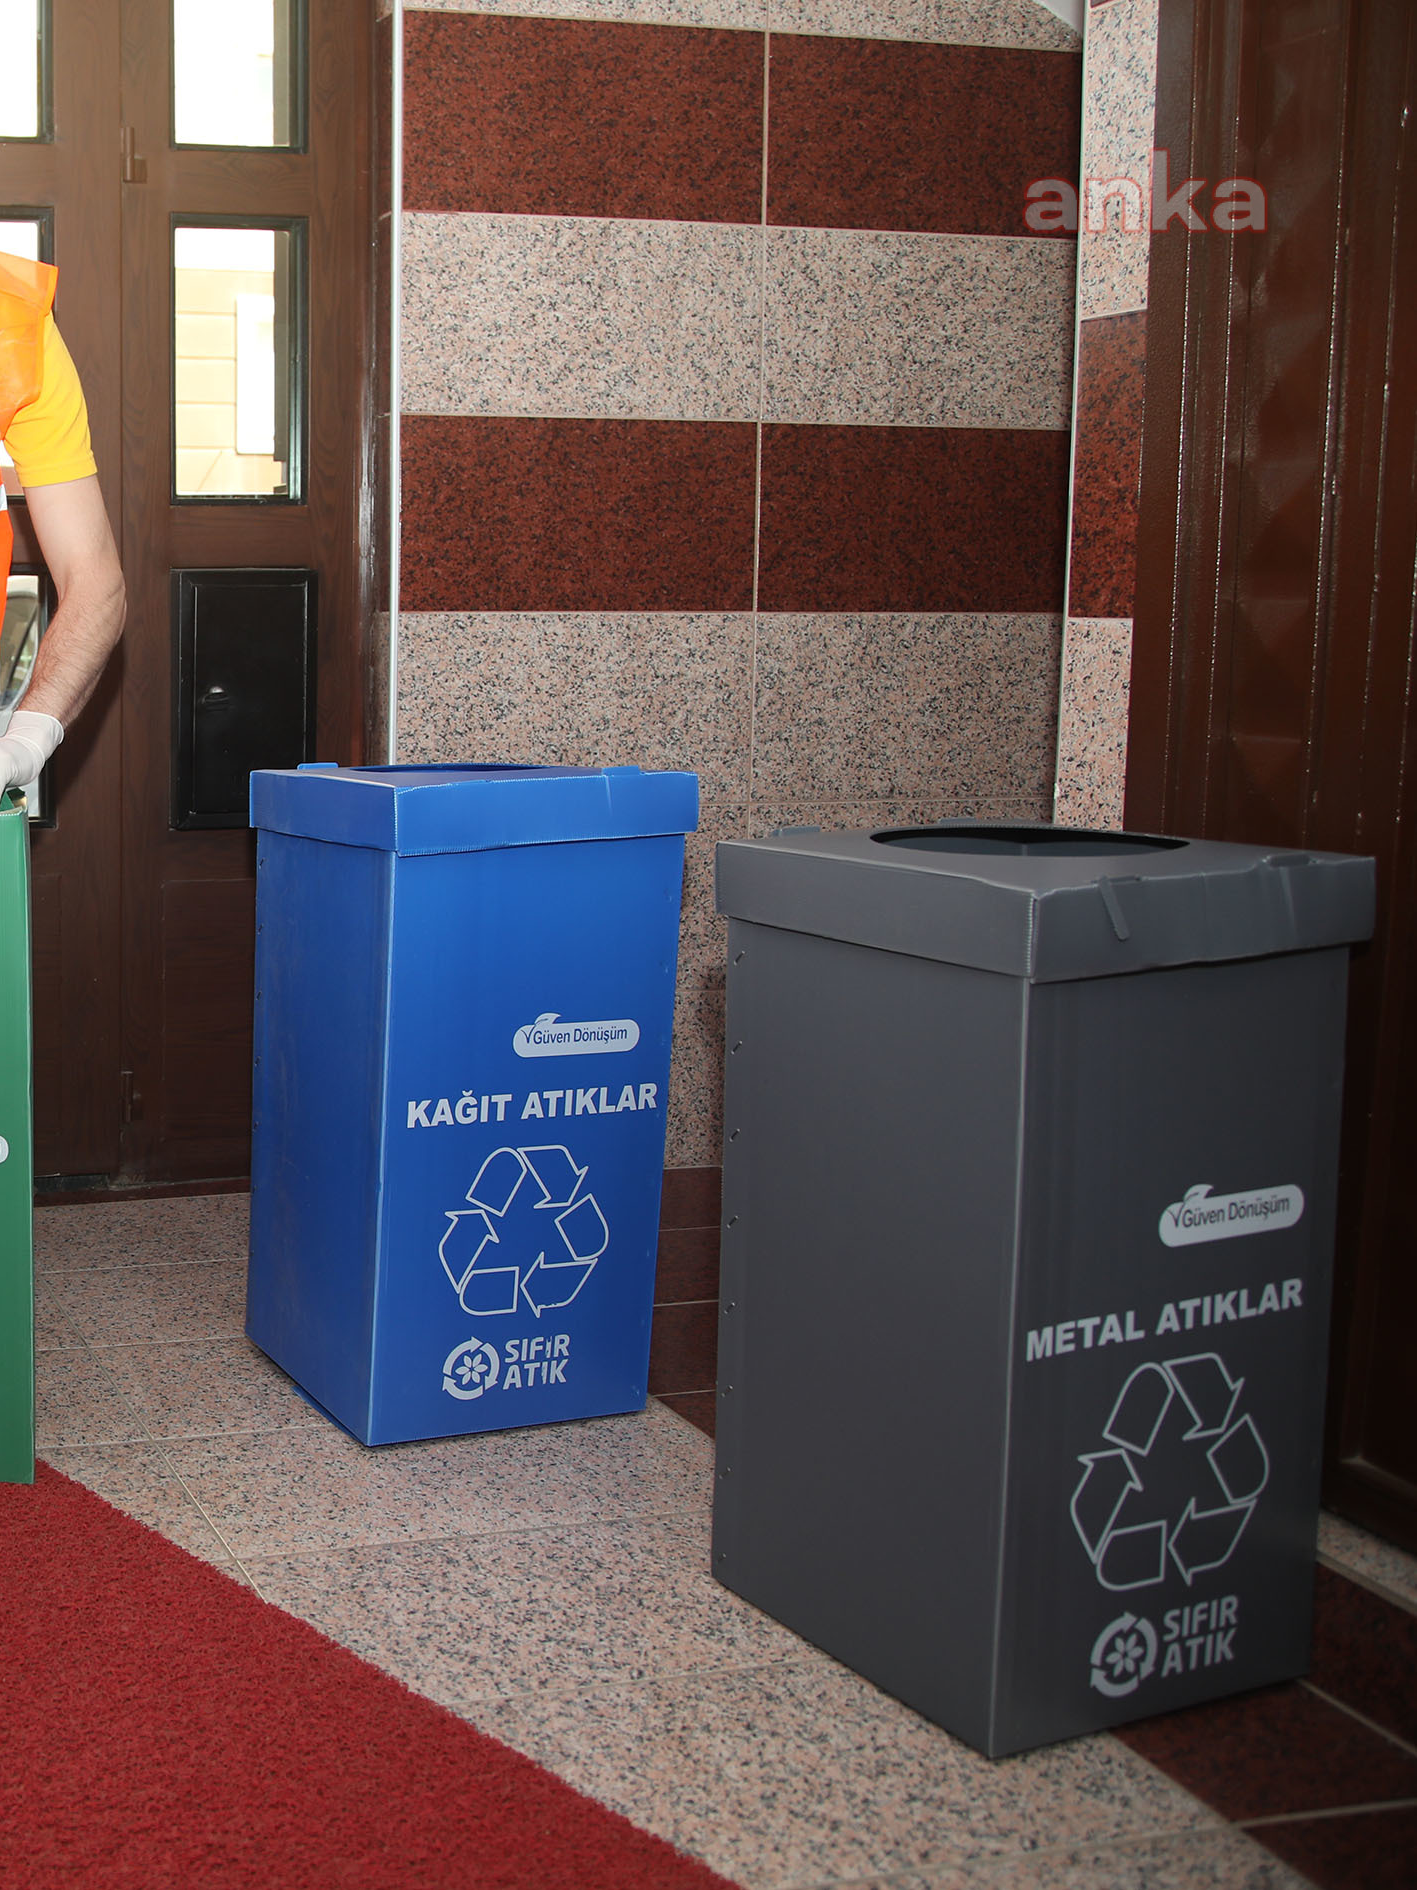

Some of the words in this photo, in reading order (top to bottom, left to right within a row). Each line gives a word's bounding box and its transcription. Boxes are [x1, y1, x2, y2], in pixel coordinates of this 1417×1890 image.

[533, 1027, 571, 1046] Güven
[573, 1026, 628, 1045] Dönüşüm
[406, 1089, 512, 1128] KAĞIT
[521, 1082, 657, 1120] ATIKLAR
[1182, 1204, 1226, 1229] Güven
[1227, 1195, 1290, 1222] Dönüşüm
[1026, 1311, 1145, 1362] METAL
[1156, 1277, 1303, 1335] ATIKLAR
[504, 1333, 571, 1364] SIFIR
[502, 1358, 567, 1391] ATIK
[1163, 1595, 1239, 1642] SIFIR
[1161, 1629, 1234, 1678] ATIK
